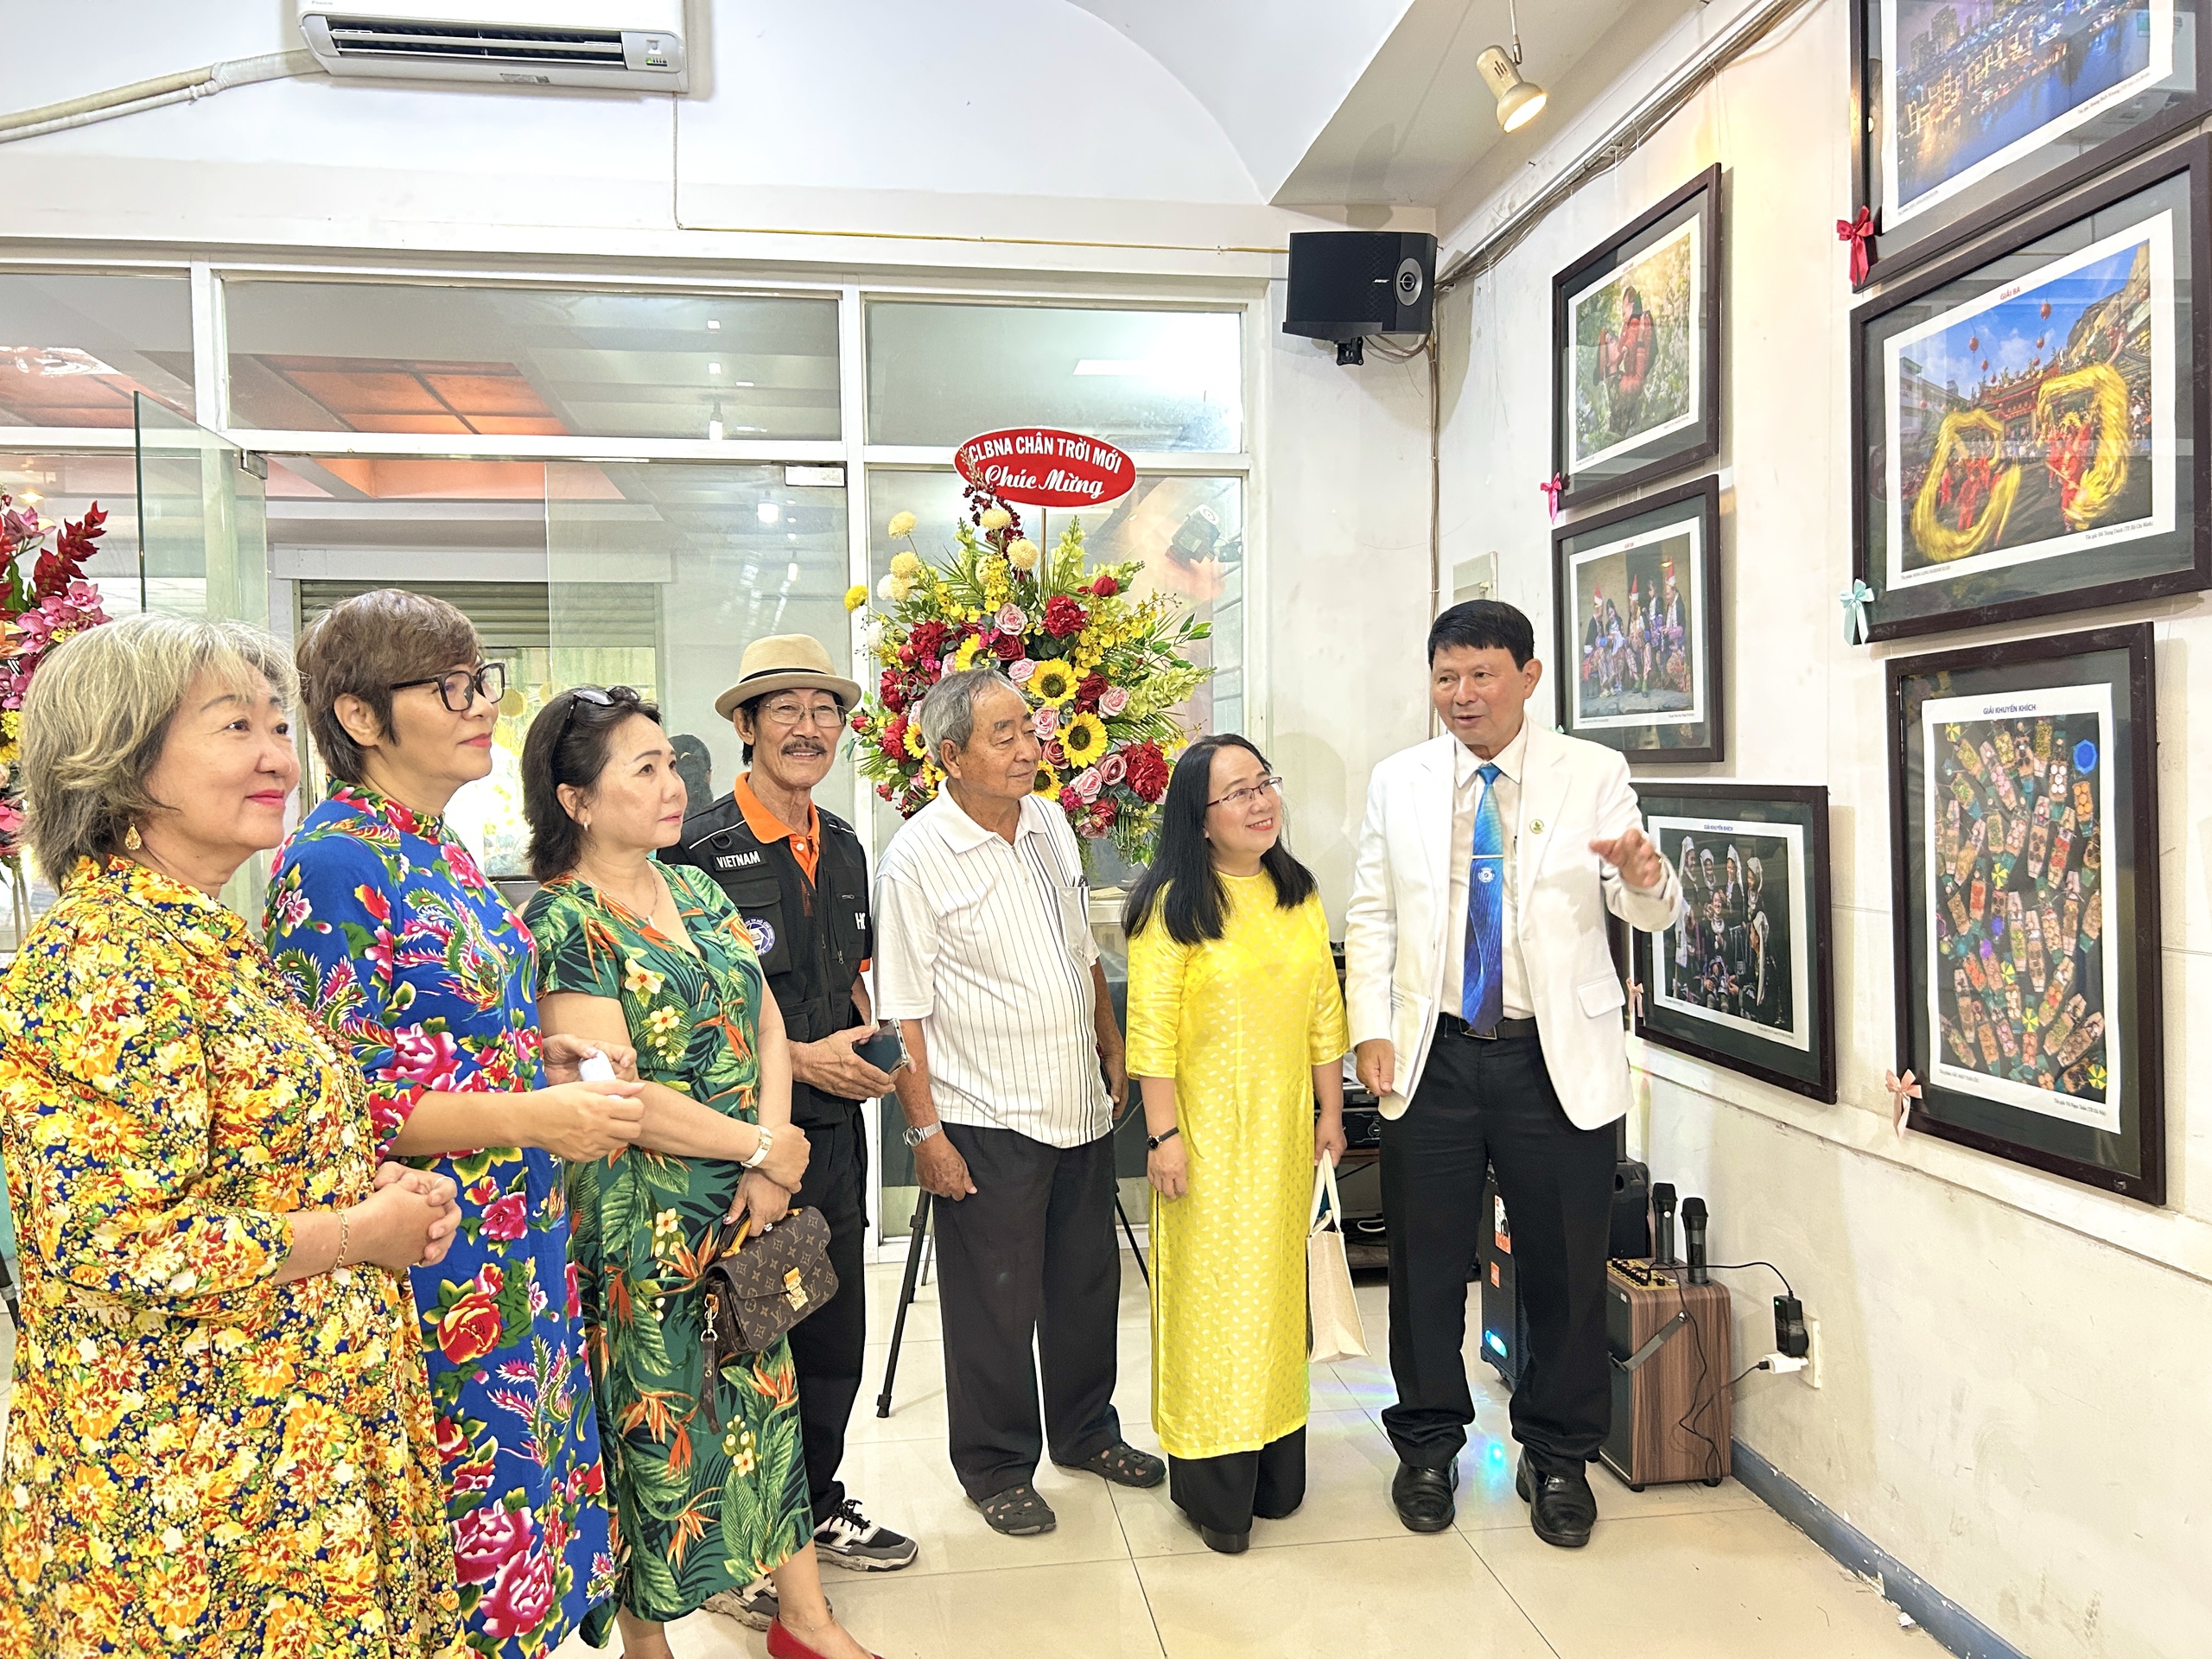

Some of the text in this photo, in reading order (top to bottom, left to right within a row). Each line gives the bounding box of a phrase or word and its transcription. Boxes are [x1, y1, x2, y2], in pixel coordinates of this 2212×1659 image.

[968, 431, 1122, 474] CLBNA CHÂN TRỜI MỚI
[985, 465, 1105, 499] Chúc Mừng
[1983, 703, 2037, 715] GIẢI KHUYẾN KHÍCH
[715, 850, 761, 868] VIETNAM
